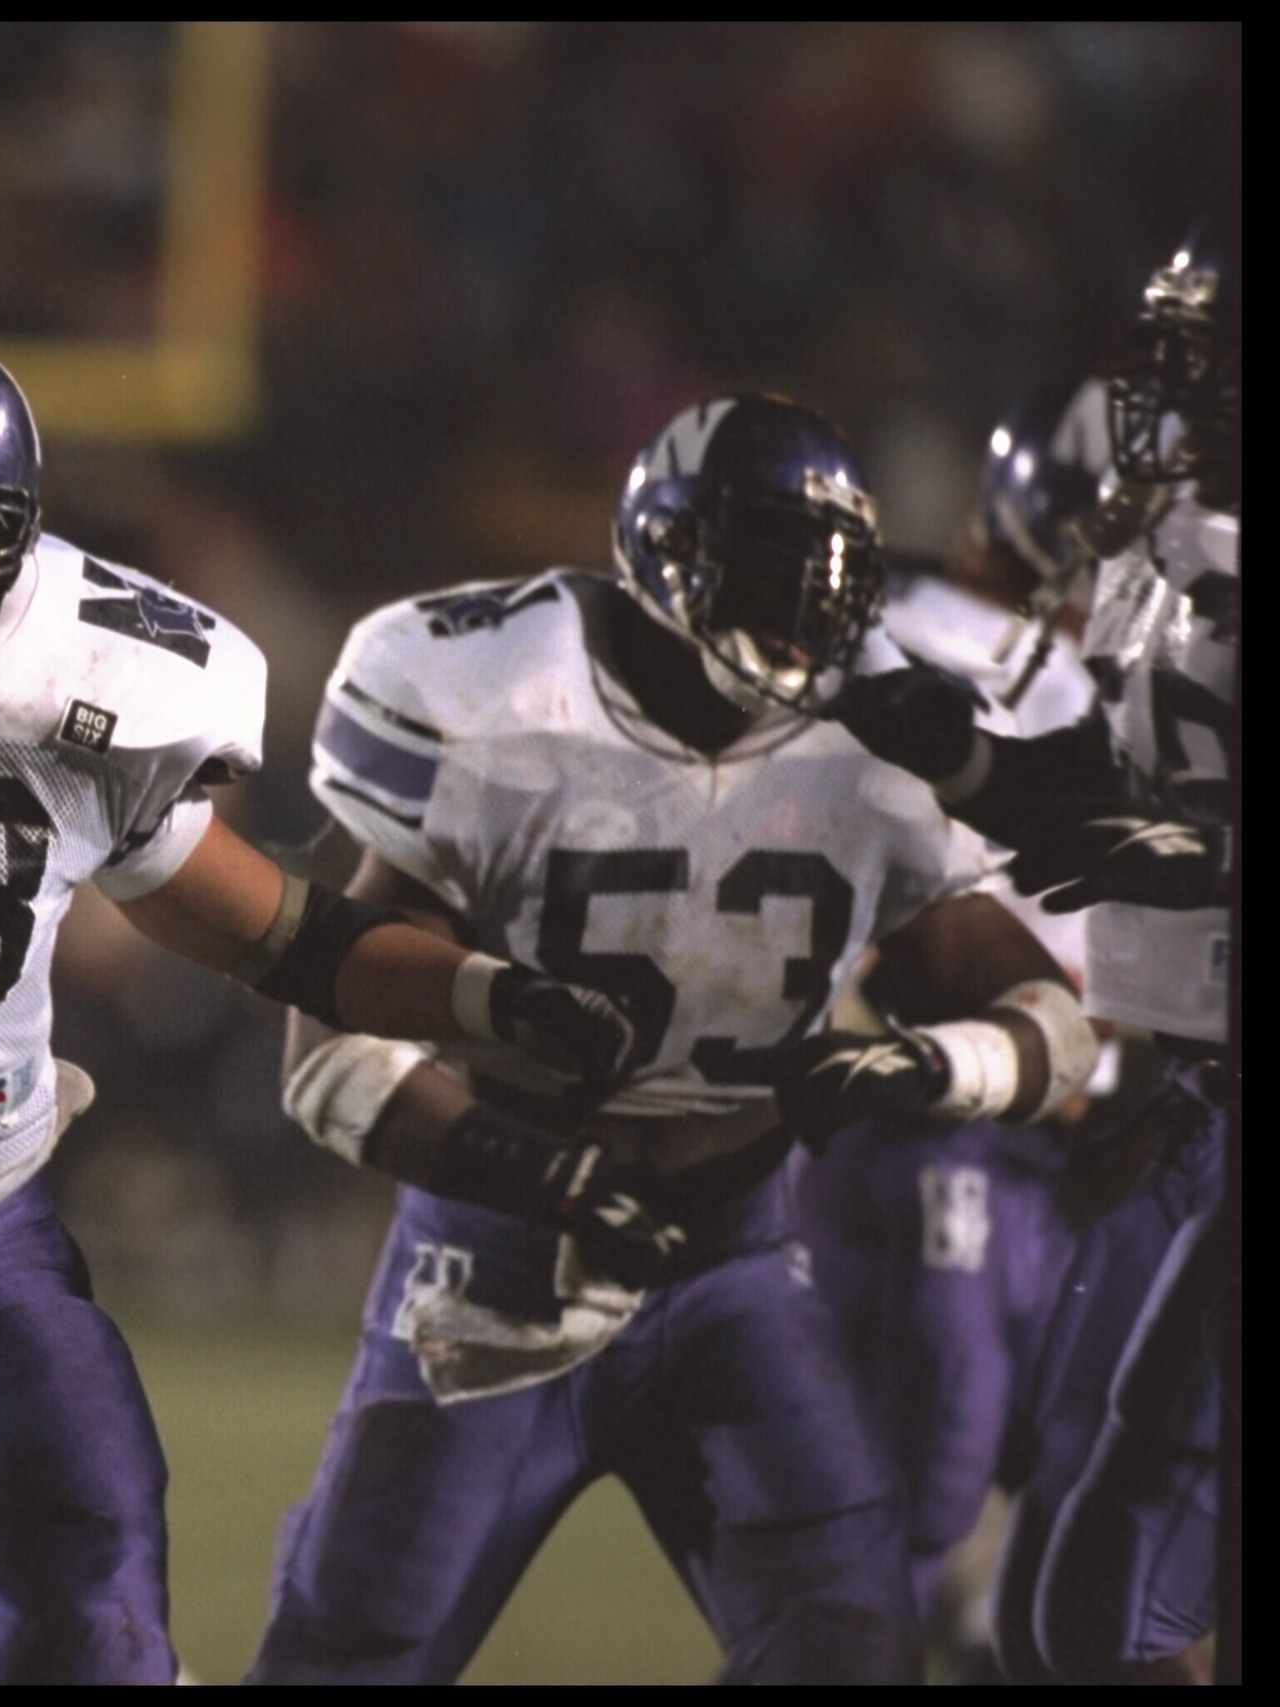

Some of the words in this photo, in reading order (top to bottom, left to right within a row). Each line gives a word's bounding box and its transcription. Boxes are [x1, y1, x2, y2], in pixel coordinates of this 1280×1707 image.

[648, 398, 738, 480] N
[71, 722, 103, 747] SIX
[76, 705, 108, 732] BIG
[535, 848, 856, 1086] 53
